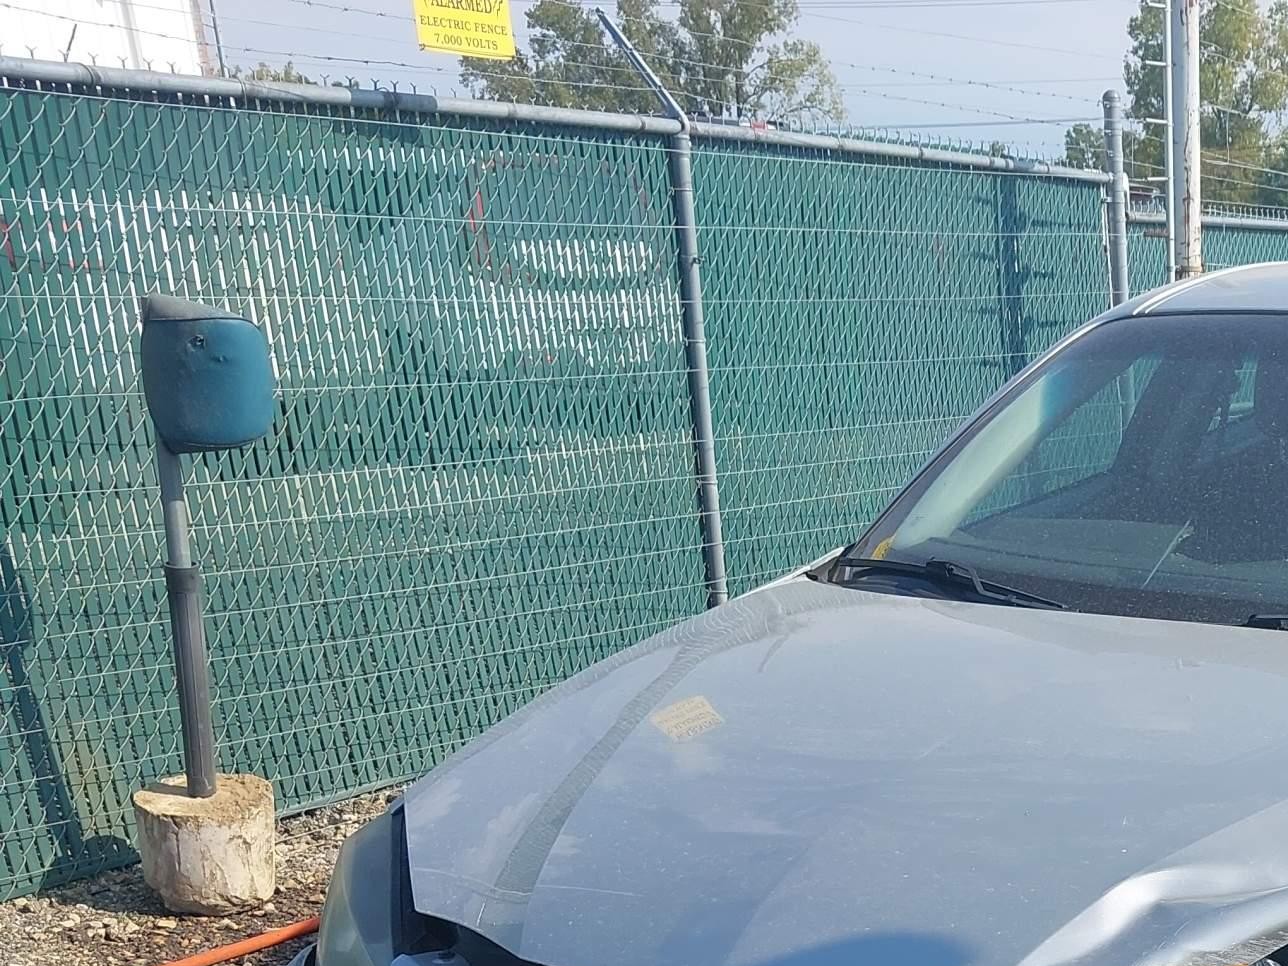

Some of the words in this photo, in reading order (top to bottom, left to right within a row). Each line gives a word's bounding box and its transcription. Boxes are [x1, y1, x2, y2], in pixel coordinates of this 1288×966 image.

[420, 15, 471, 31] ELECTRIC
[474, 22, 508, 36] FENCE
[434, 33, 462, 45] 7,000
[465, 37, 498, 50] VOLTS
